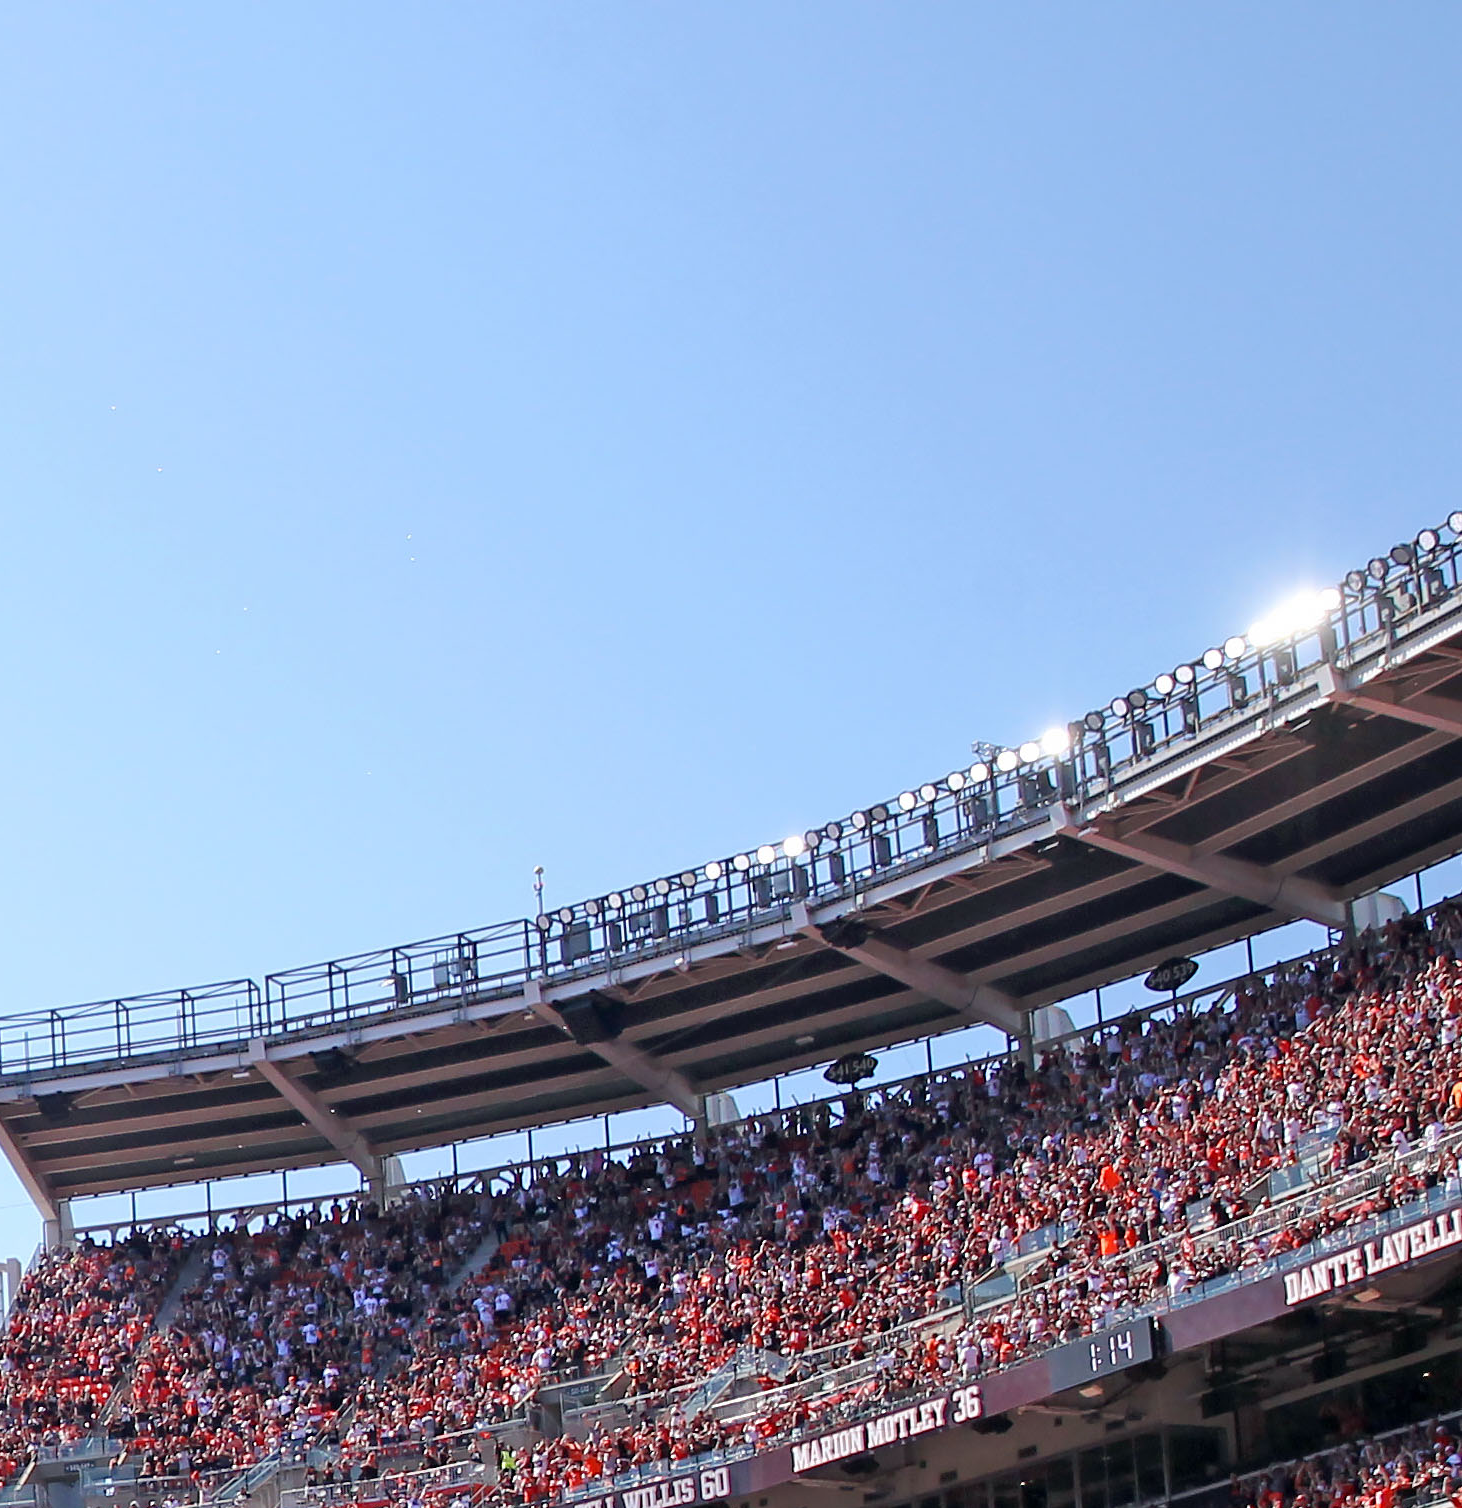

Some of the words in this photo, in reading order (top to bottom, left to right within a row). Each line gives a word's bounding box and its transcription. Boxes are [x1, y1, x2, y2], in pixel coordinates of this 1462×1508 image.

[1284, 1247, 1366, 1306] DANTE
[1090, 1330, 1133, 1372] 1:14
[791, 1421, 865, 1474] MARION
[866, 1398, 948, 1451] MOTLEY
[952, 1385, 982, 1425] 36
[700, 1467, 731, 1501] 60
